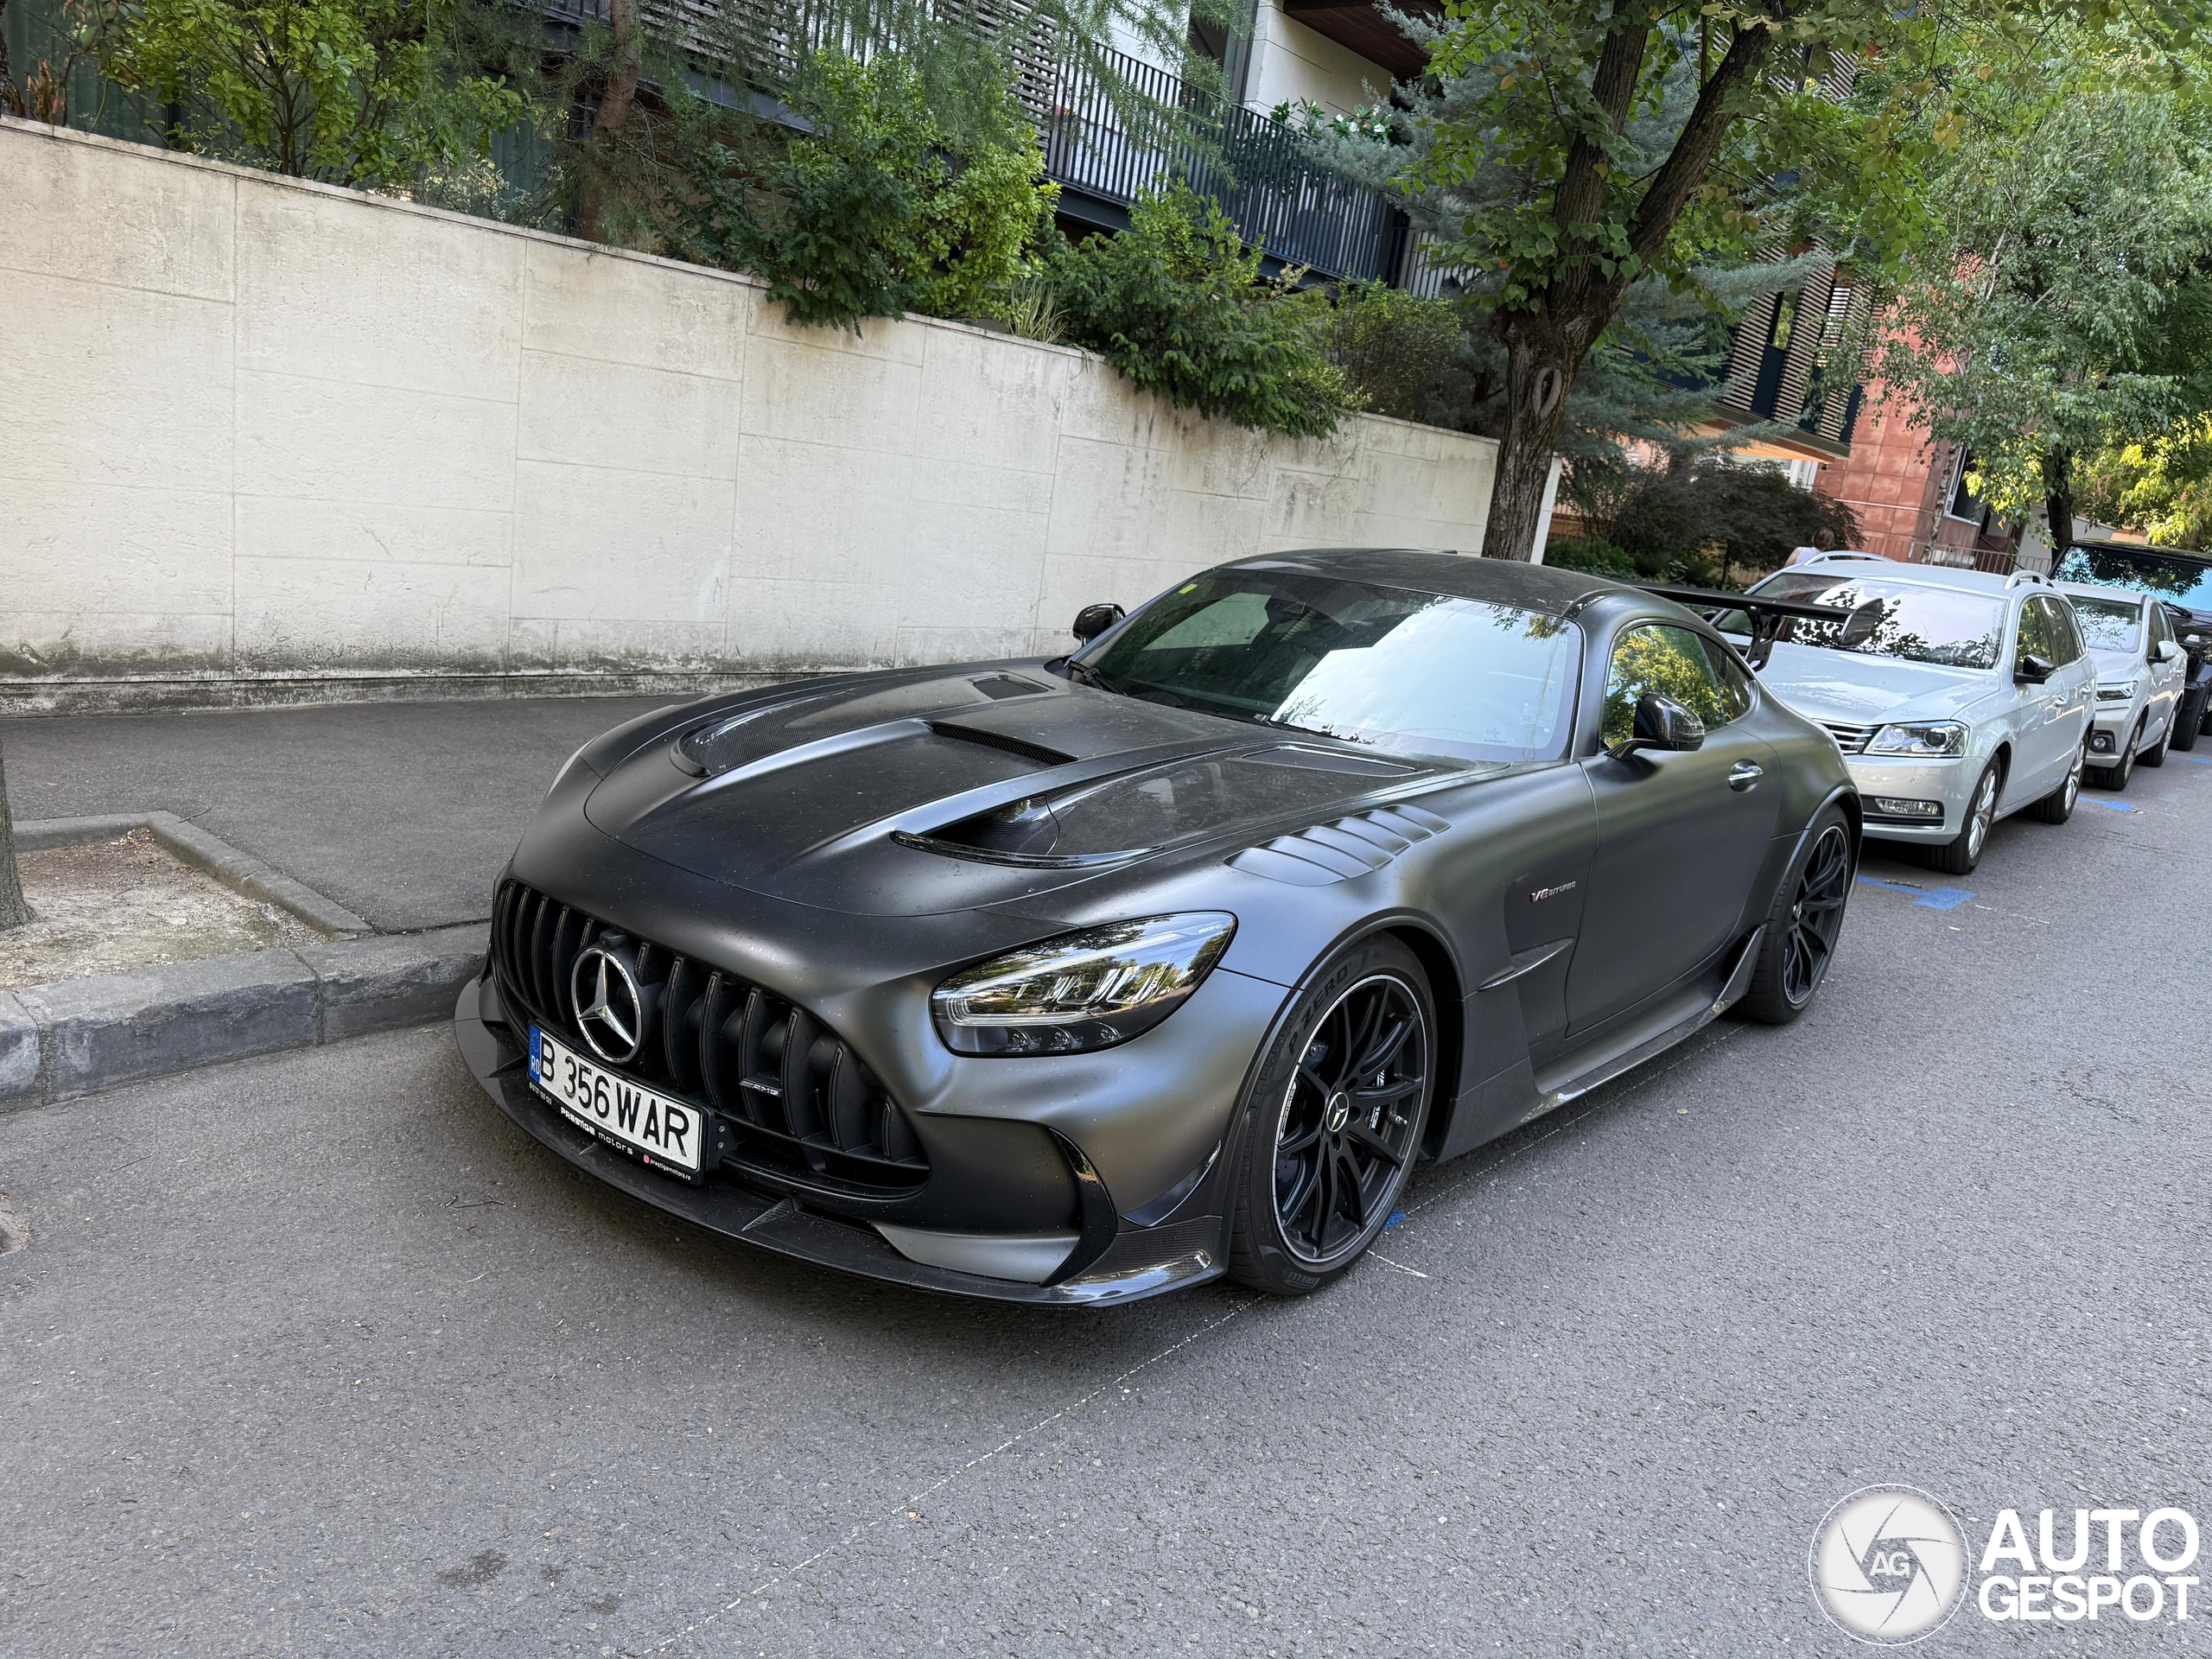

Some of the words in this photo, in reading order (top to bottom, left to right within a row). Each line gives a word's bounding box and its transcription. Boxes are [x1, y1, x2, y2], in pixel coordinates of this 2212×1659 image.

[1288, 1031, 1299, 1056] P
[1301, 963, 1348, 1031] ZERO
[531, 1054, 540, 1076] RO
[540, 1035, 556, 1082] B
[563, 1055, 611, 1119] 356
[616, 1082, 690, 1158] WAR
[598, 1132, 633, 1155] motors
[1284, 1271, 1321, 1290] PIRELLI
